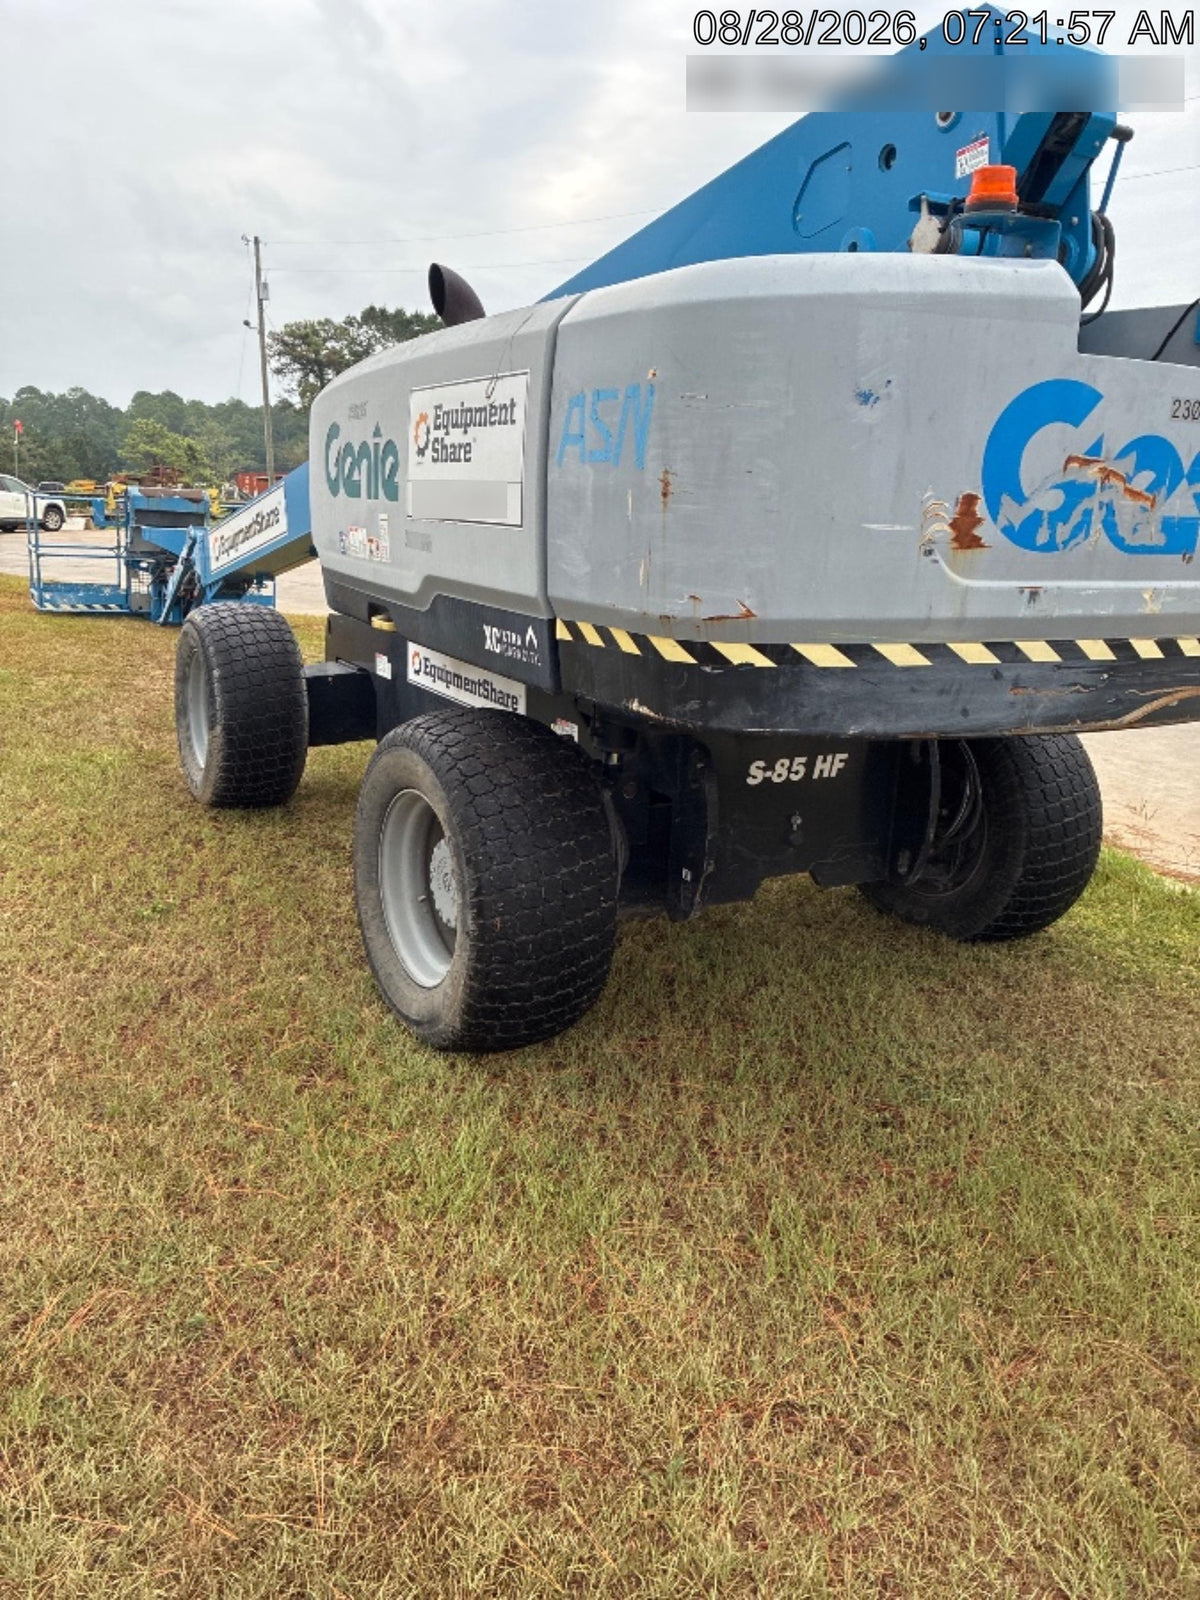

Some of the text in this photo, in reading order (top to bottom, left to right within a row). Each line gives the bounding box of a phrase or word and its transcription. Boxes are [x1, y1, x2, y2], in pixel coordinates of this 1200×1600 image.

[432, 398, 517, 436] Equipment
[557, 382, 656, 471] ASN
[325, 421, 399, 502] Genie
[431, 437, 472, 463] Share
[981, 378, 1200, 556] Ge
[423, 657, 519, 711] EquipmentShare
[745, 753, 849, 785] S-85 HF
